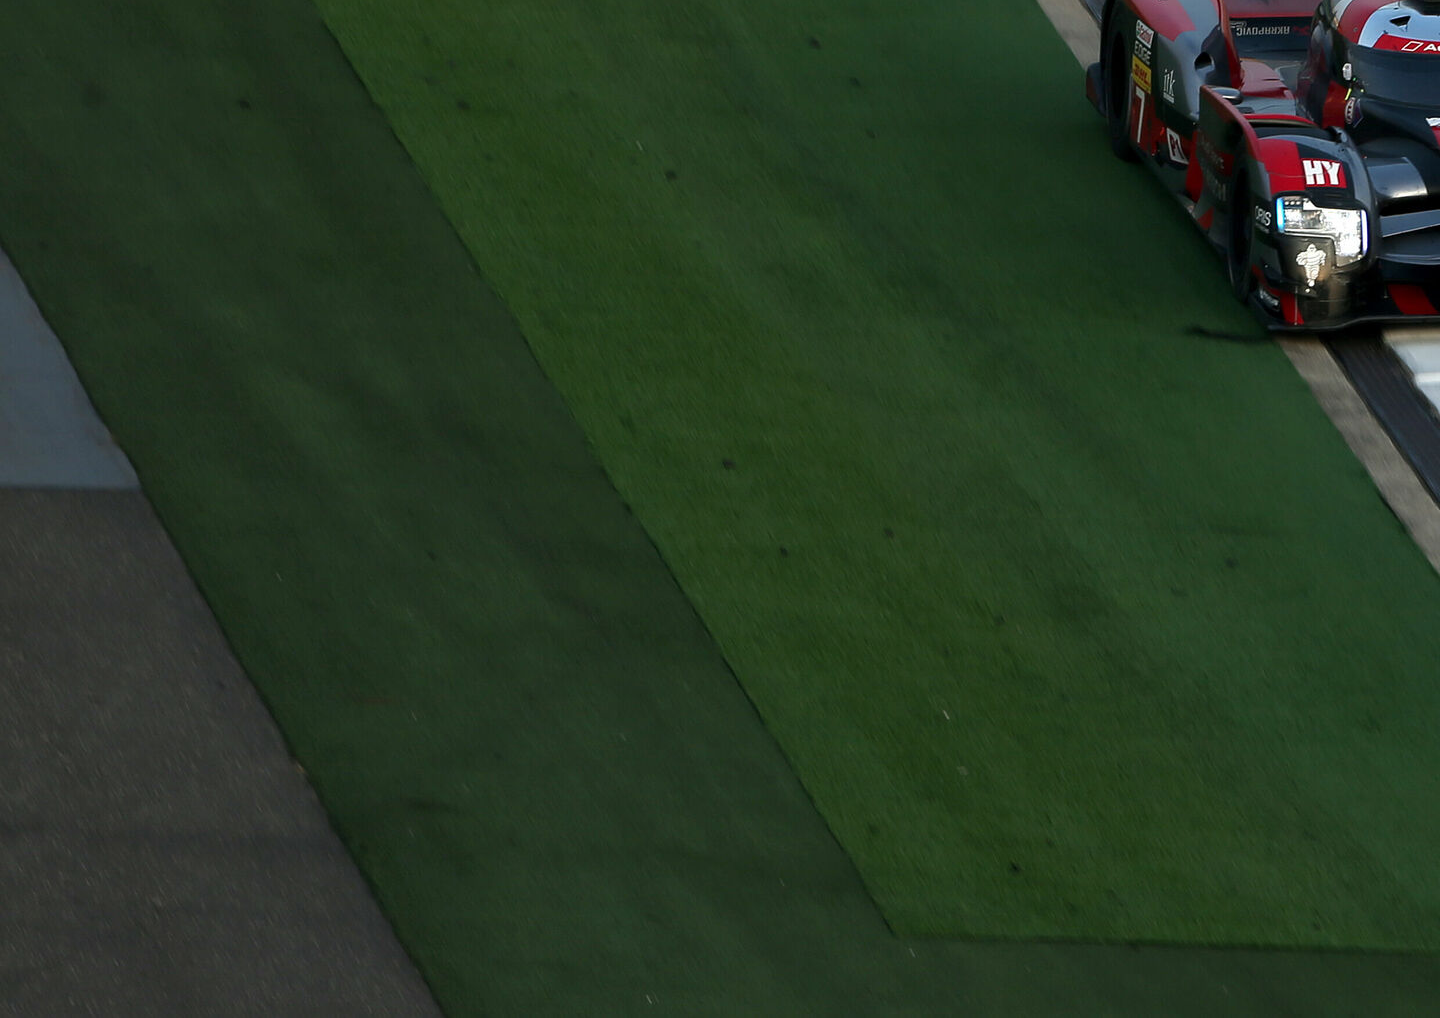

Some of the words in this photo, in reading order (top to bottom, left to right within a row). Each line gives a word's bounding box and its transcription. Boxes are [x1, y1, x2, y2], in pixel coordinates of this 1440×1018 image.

[1134, 40, 1152, 66] EDGE
[1135, 85, 1146, 143] 7
[1302, 159, 1341, 186] HY
